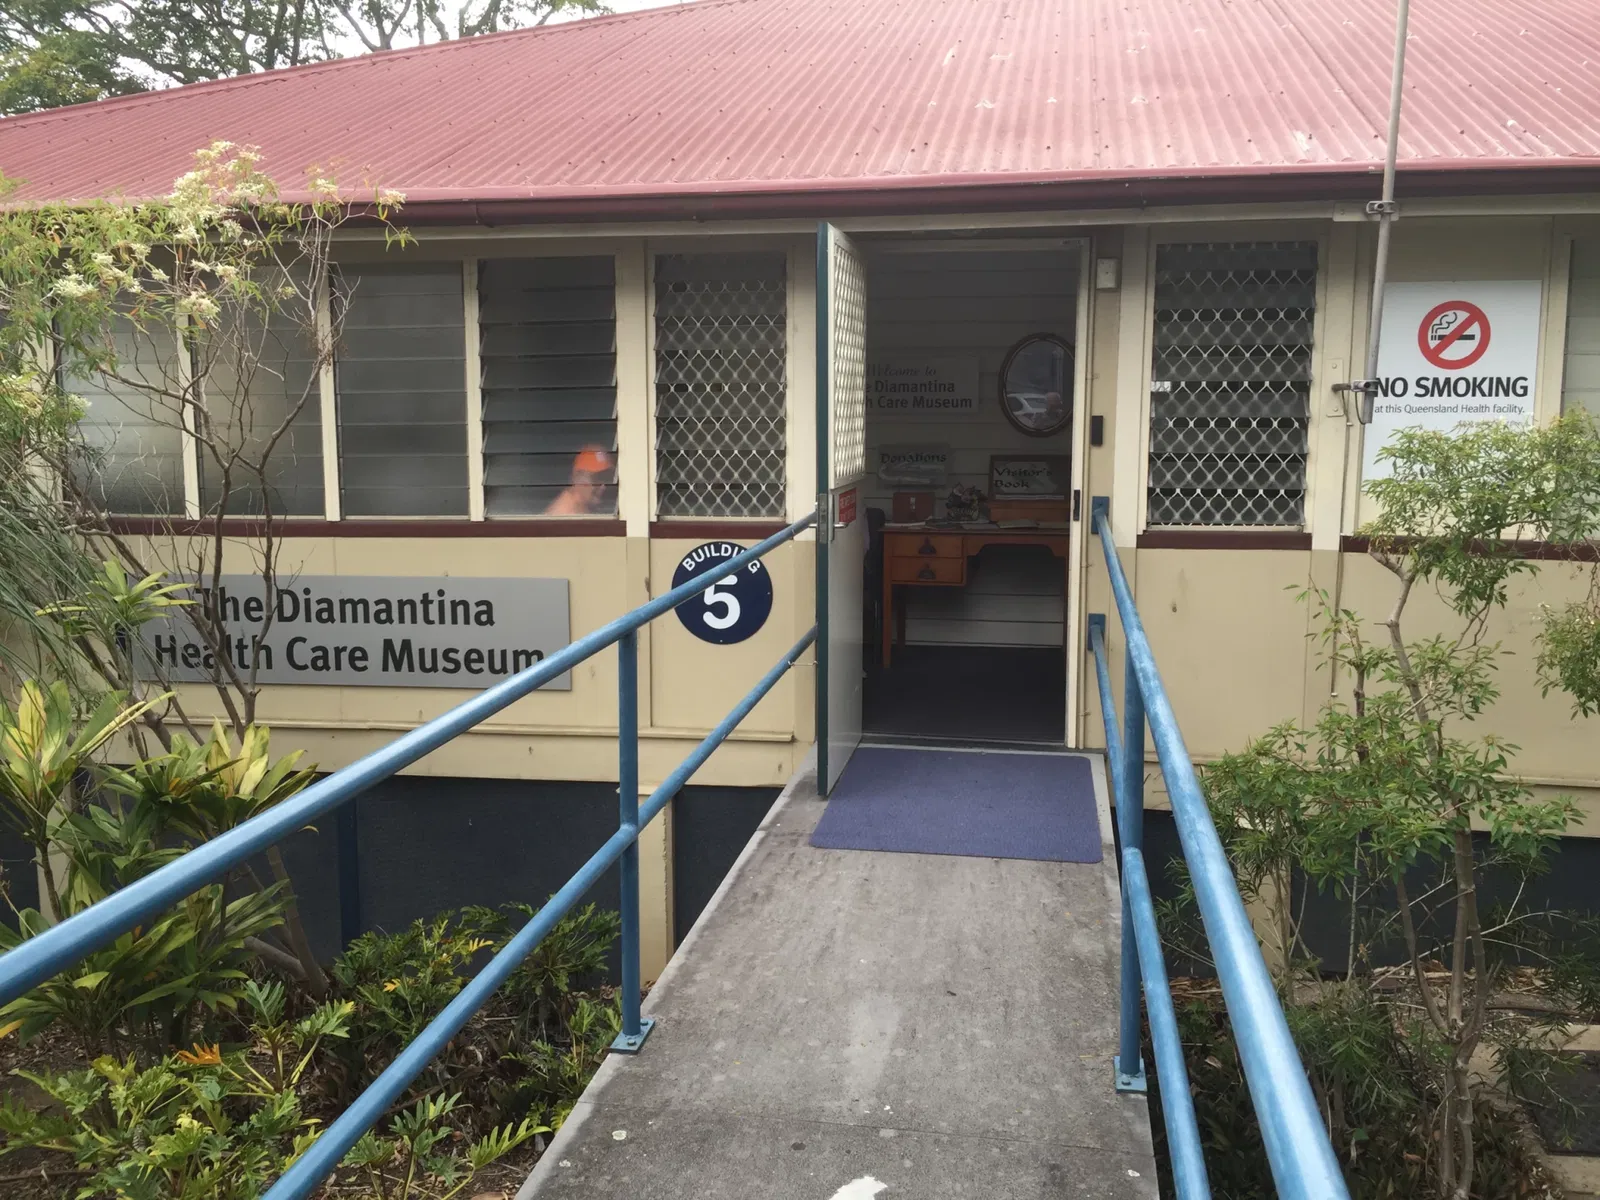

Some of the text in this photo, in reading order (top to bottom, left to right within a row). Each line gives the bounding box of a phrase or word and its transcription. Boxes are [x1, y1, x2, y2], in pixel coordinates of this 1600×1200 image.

[875, 380, 955, 393] Diamantina
[1375, 376, 1529, 398] NO SMOKING
[877, 395, 909, 409] Care
[912, 395, 973, 409] Museum
[1374, 404, 1526, 415] at this Queensland Health facility.
[682, 544, 761, 574] BUILDIG
[196, 586, 496, 627] The Diamantina
[703, 574, 741, 630] 5
[154, 634, 545, 675] Health Care Museum
